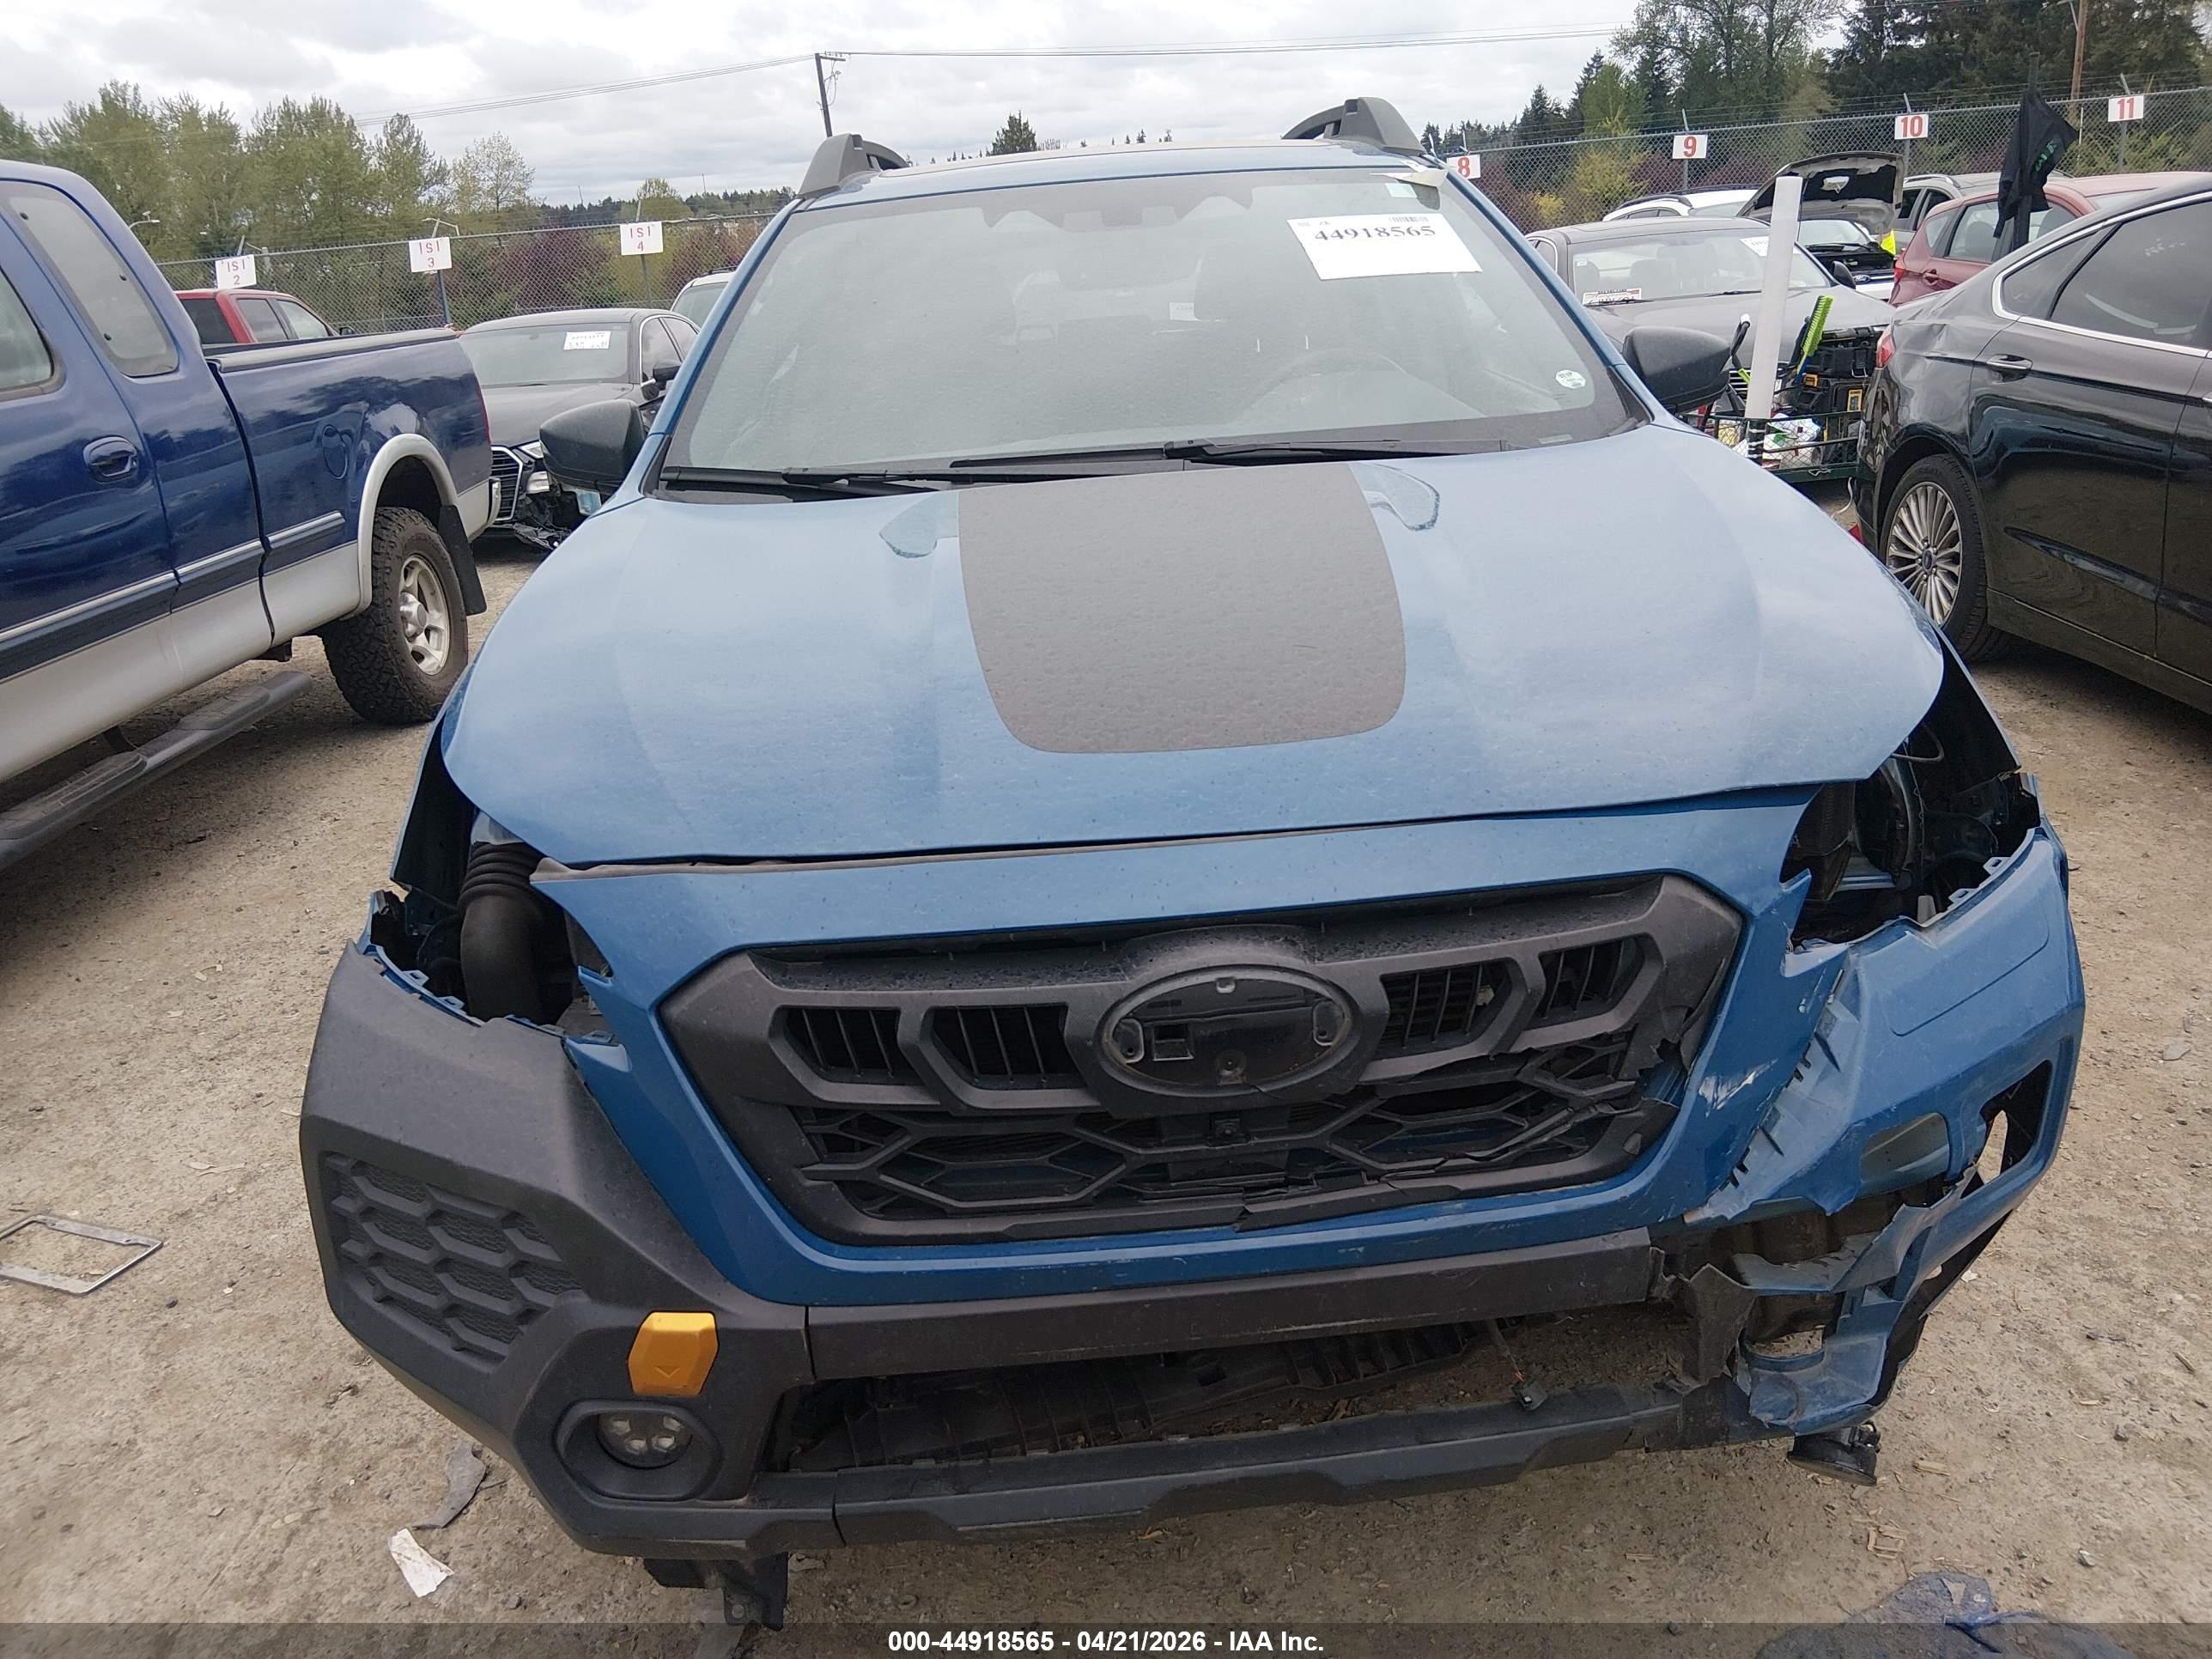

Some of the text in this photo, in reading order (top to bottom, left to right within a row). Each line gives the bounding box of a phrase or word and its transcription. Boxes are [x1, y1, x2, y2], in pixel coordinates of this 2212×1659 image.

[2117, 97, 2134, 119] 11
[1900, 116, 1923, 137] 10
[1683, 136, 1697, 157] 9
[1457, 156, 1470, 178] 8
[1315, 225, 1436, 241] 44918565
[637, 240, 644, 252] 4
[428, 258, 434, 268] 3
[233, 275, 240, 285] 2
